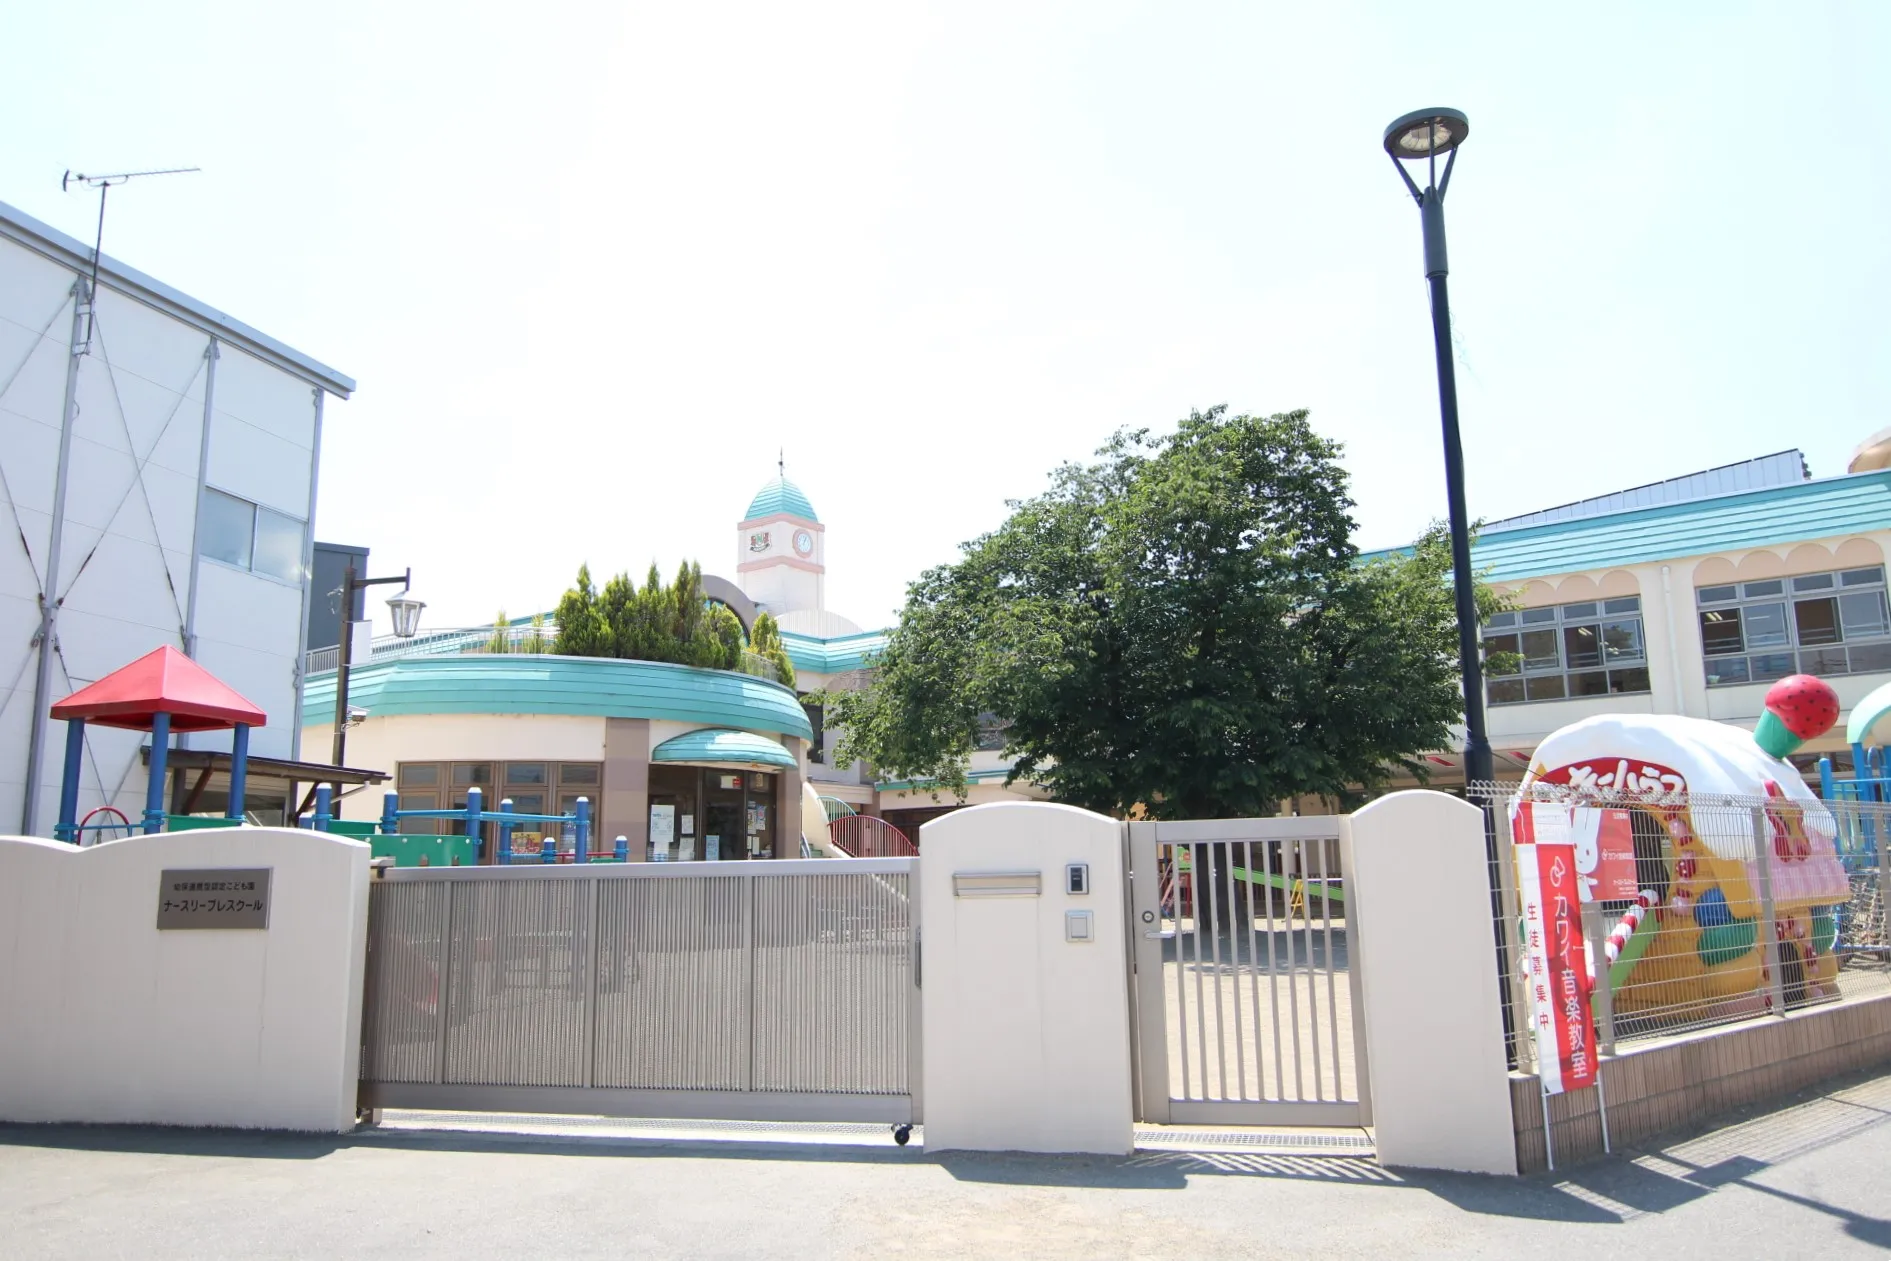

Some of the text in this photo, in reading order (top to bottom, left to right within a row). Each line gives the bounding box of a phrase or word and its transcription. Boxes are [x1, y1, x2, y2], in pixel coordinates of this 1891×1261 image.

[1527, 903, 1549, 1031] 生徒募集中
[1554, 894, 1588, 1079] カワイ音楽教室
